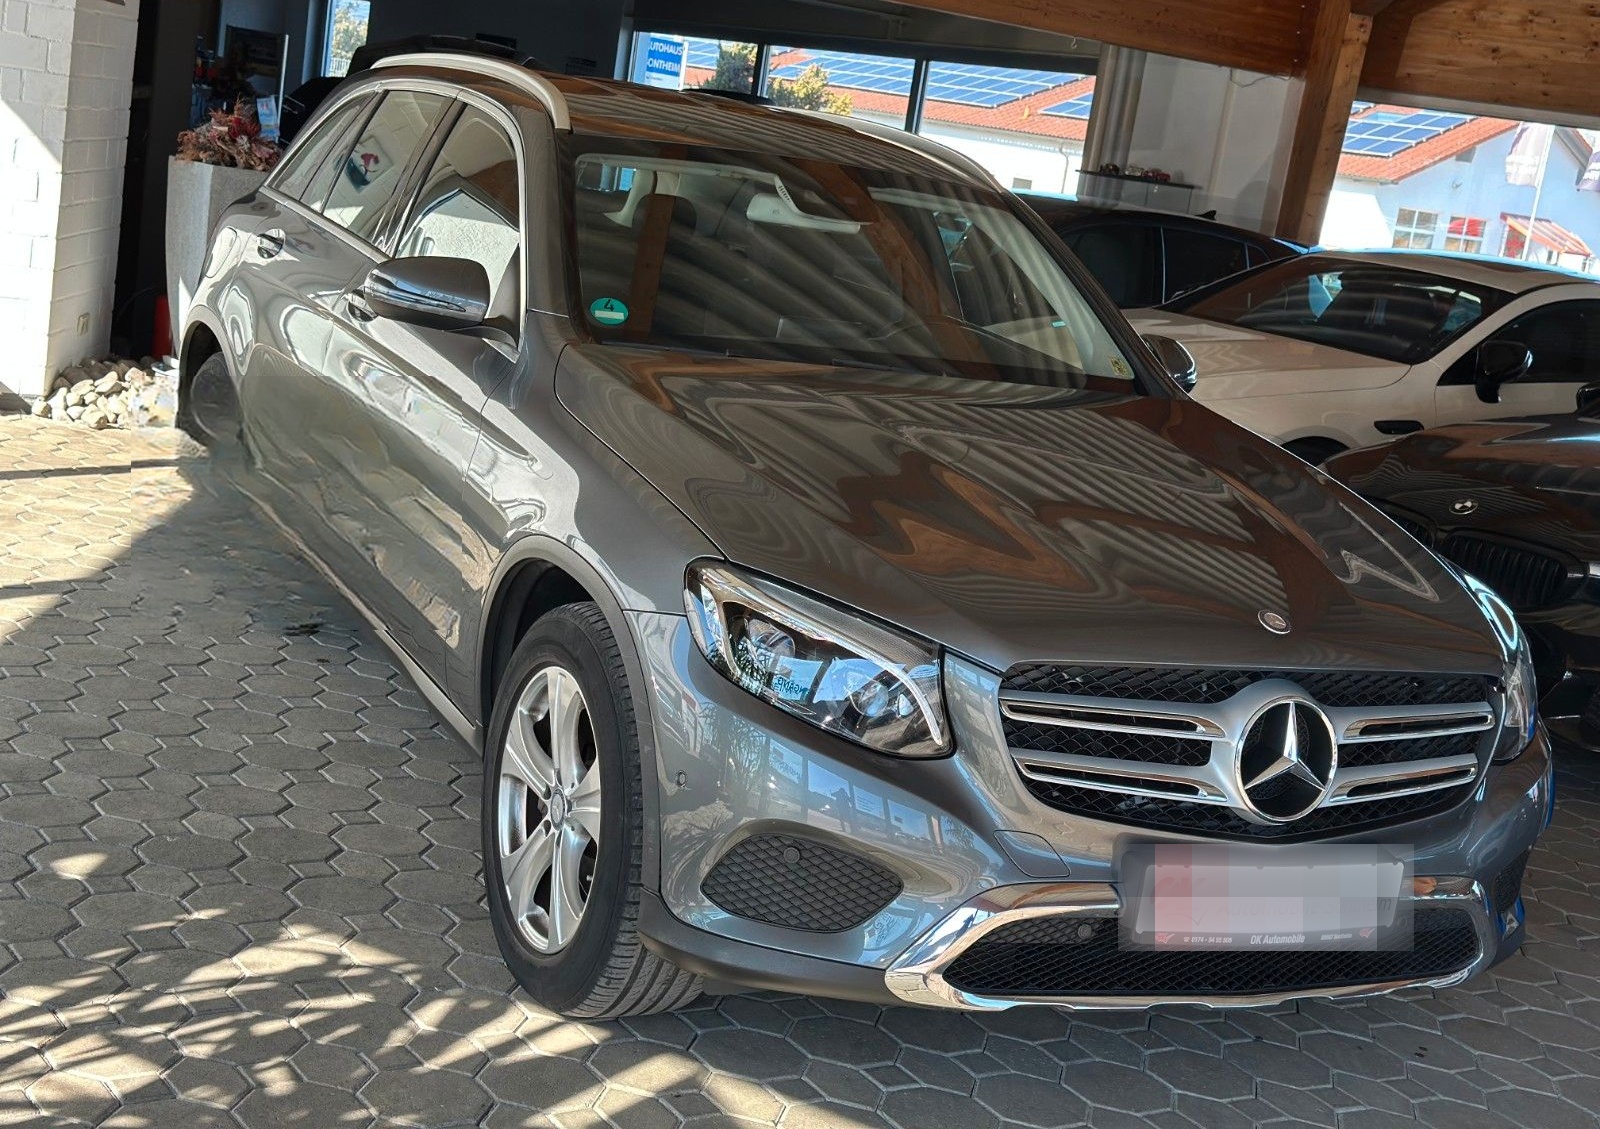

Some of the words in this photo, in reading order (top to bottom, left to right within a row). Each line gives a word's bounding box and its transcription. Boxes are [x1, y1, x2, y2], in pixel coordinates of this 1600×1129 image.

[648, 41, 682, 56] UTOHAUS
[647, 58, 681, 72] ONTHEIM
[603, 299, 615, 311] 4
[1250, 935, 1262, 945] OK
[1262, 933, 1305, 945] Automobile
